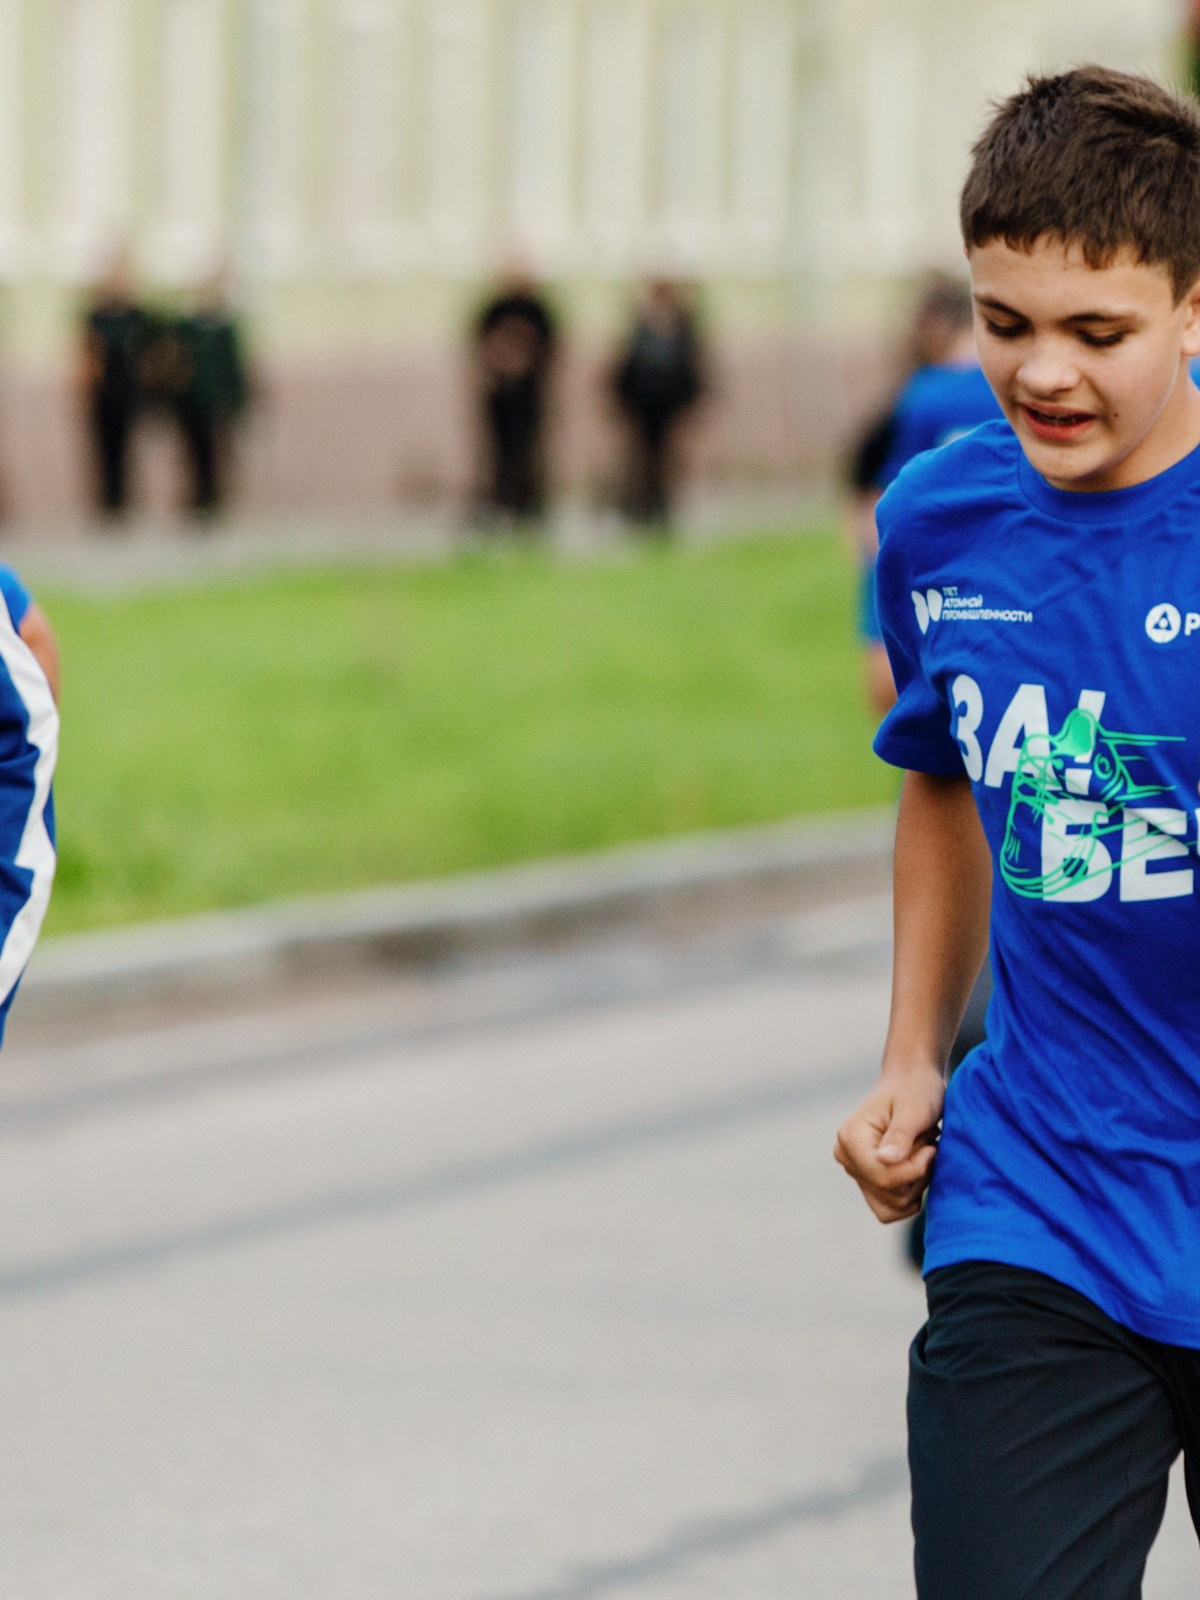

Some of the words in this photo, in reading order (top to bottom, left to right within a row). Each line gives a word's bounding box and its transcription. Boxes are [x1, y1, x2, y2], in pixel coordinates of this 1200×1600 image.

[944, 594, 983, 608] АТОМНОЙ
[942, 609, 1034, 623] ПРОМЫШЛЕННОСТИ
[950, 674, 1106, 796] ЗА!
